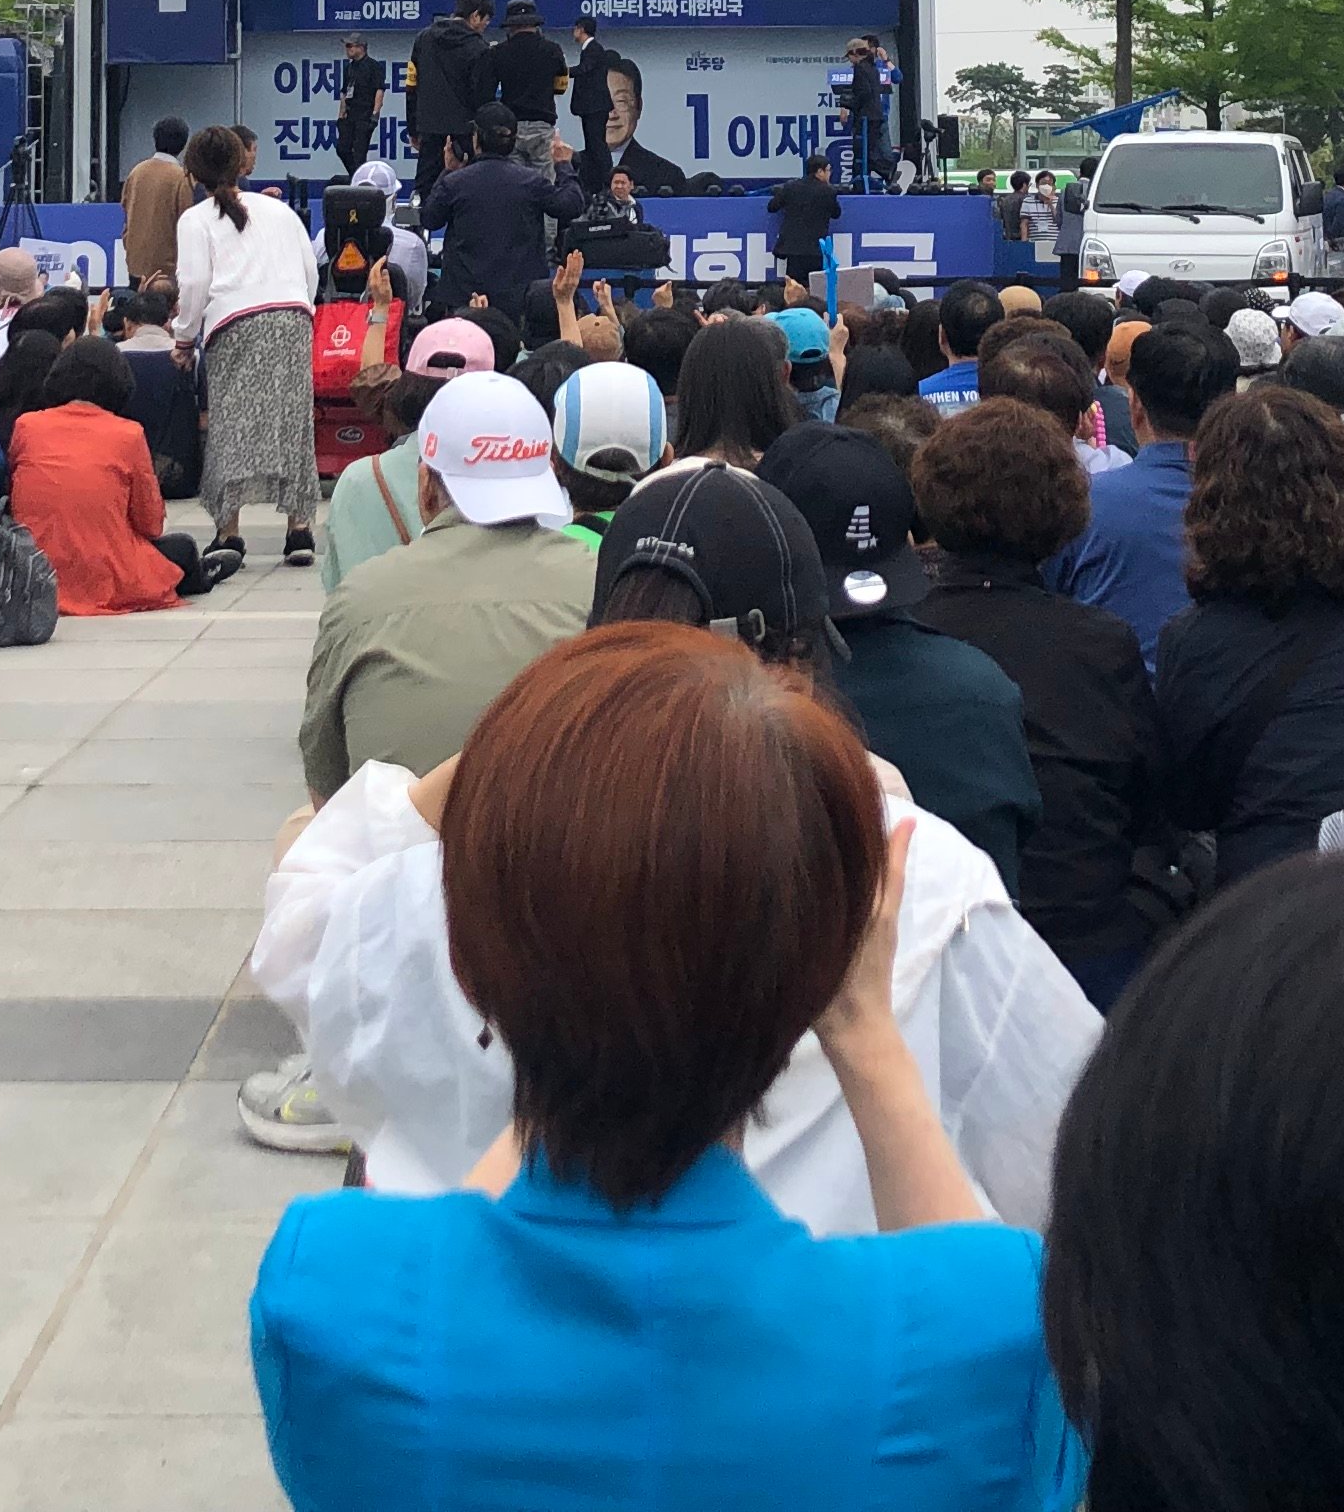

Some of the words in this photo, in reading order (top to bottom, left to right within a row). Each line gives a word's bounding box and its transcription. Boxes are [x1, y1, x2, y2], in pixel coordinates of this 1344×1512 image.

[362, 0, 420, 20] 이재명
[580, 0, 643, 18] 이제부터
[686, 57, 725, 71] 민주당
[686, 93, 710, 159] 1
